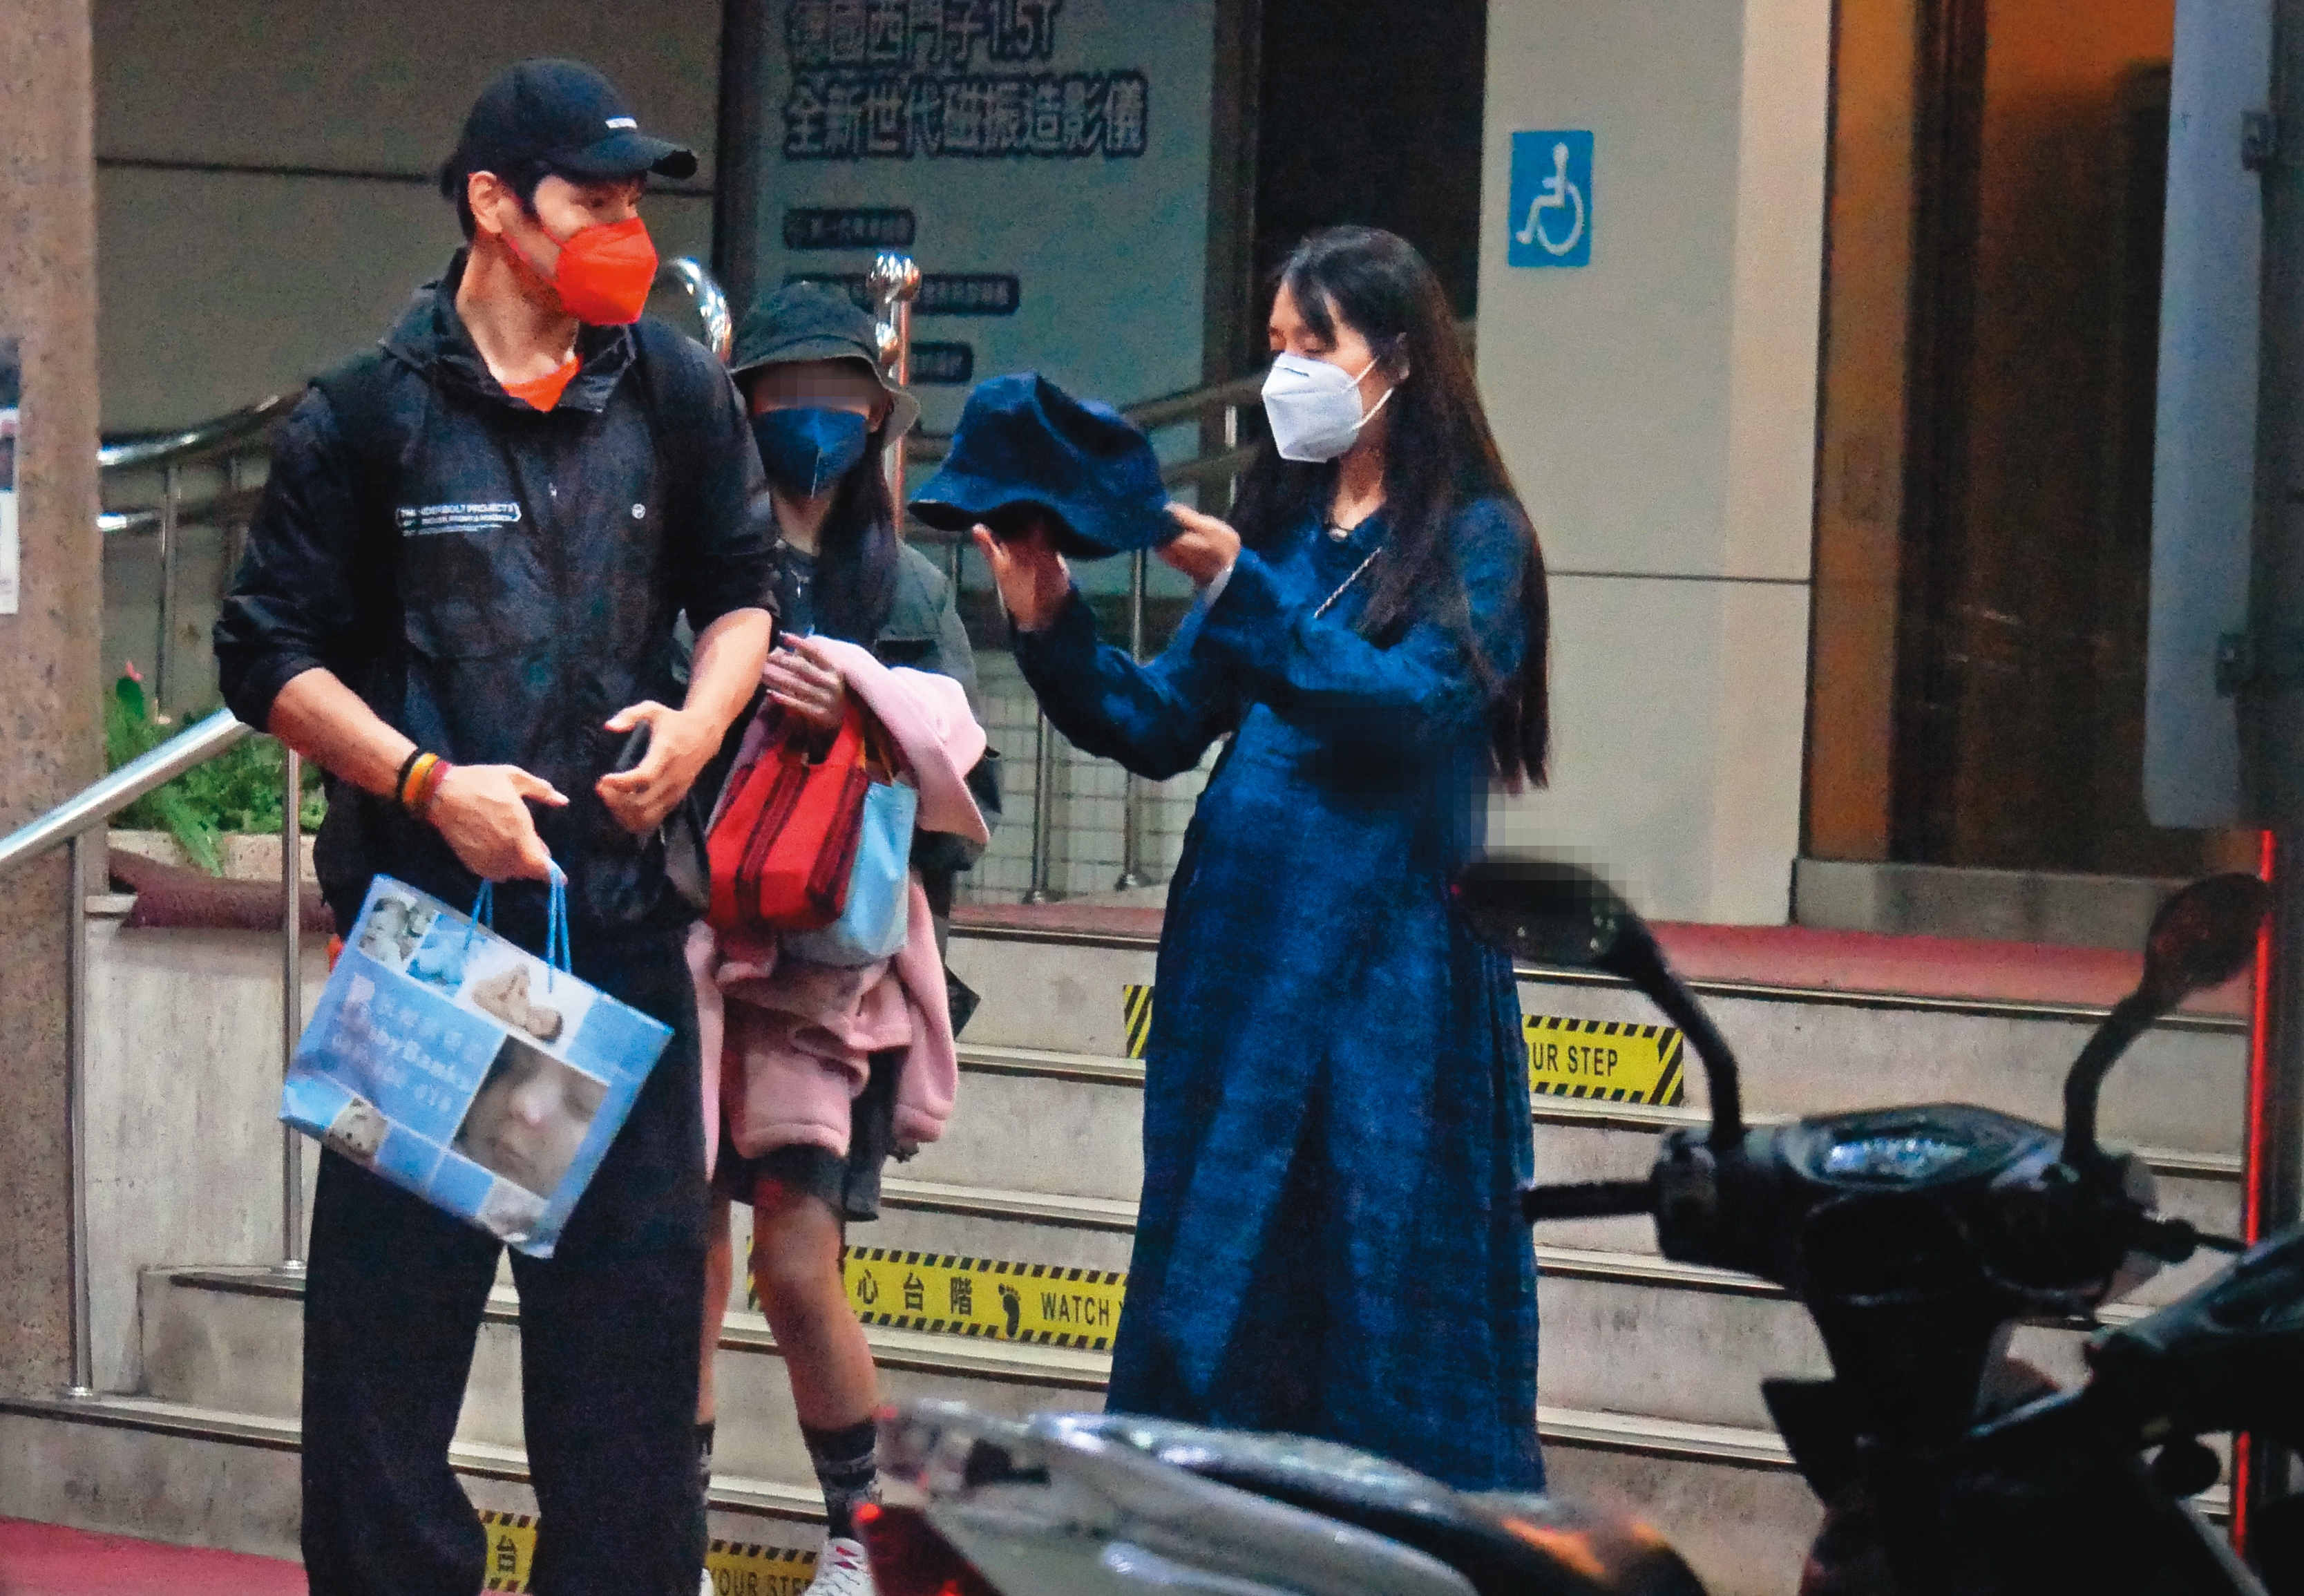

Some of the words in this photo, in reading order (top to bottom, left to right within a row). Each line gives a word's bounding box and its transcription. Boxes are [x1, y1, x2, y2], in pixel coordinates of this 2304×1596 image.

[1527, 1041, 1559, 1072] UR
[1568, 1045, 1618, 1077] STEP
[1040, 1291, 1110, 1327] WATCH
